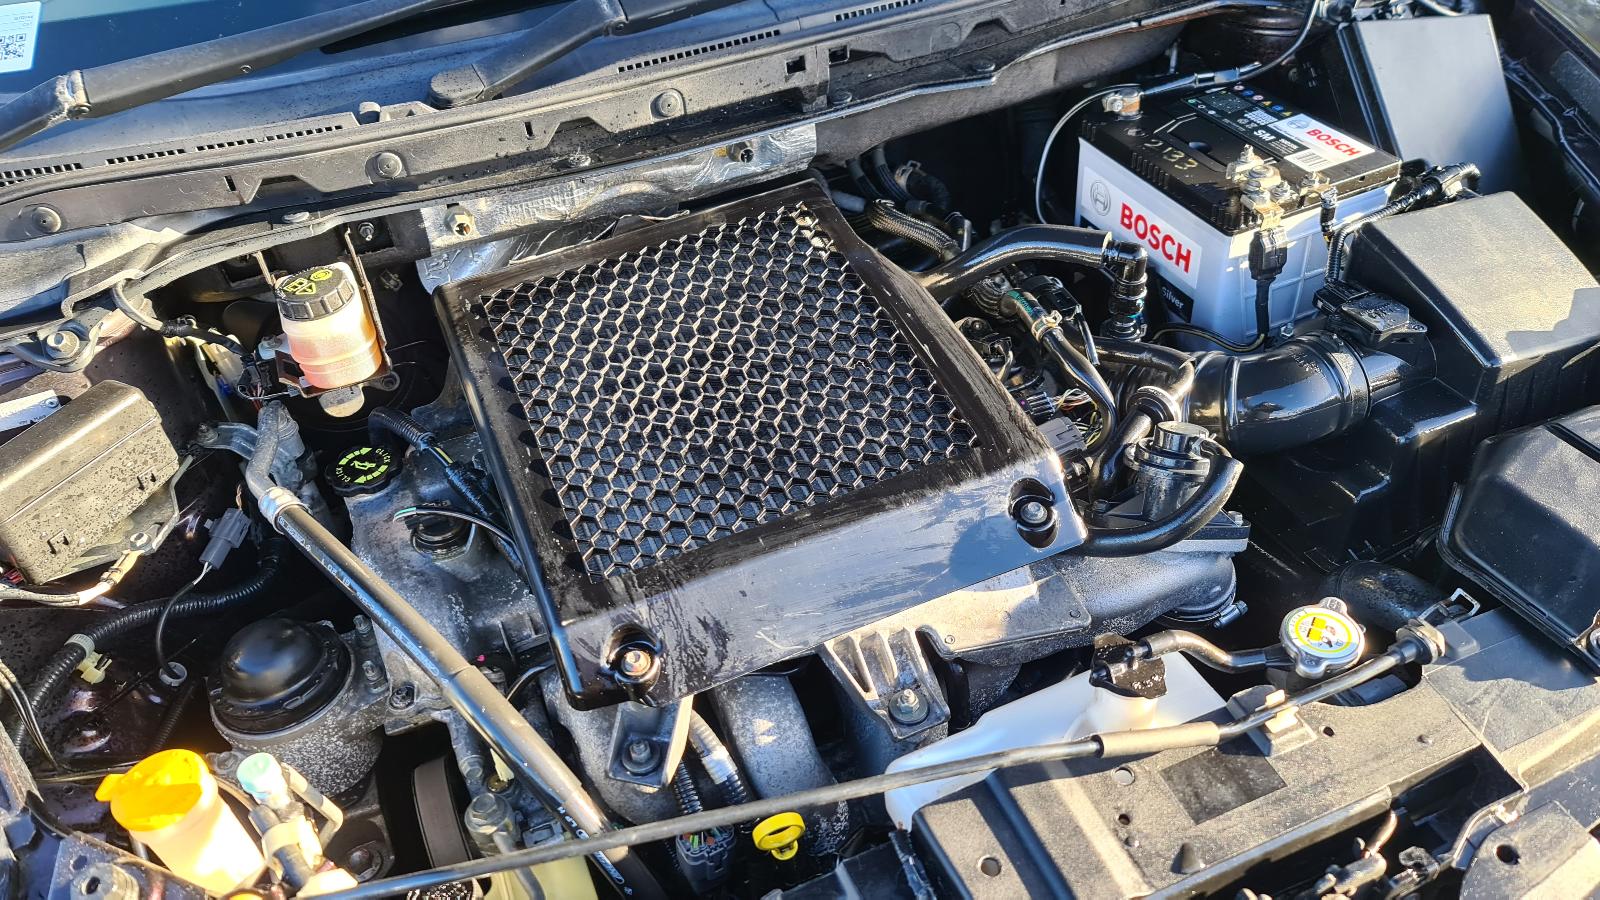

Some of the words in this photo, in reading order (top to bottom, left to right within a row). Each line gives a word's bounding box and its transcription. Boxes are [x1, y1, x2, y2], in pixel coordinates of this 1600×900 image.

[1254, 129, 1277, 141] SM
[1306, 129, 1361, 156] BOSCH
[1120, 202, 1192, 273] BOSCH
[1161, 286, 1184, 309] Silver
[375, 448, 391, 463] CLICK
[335, 466, 351, 482] CLICK
